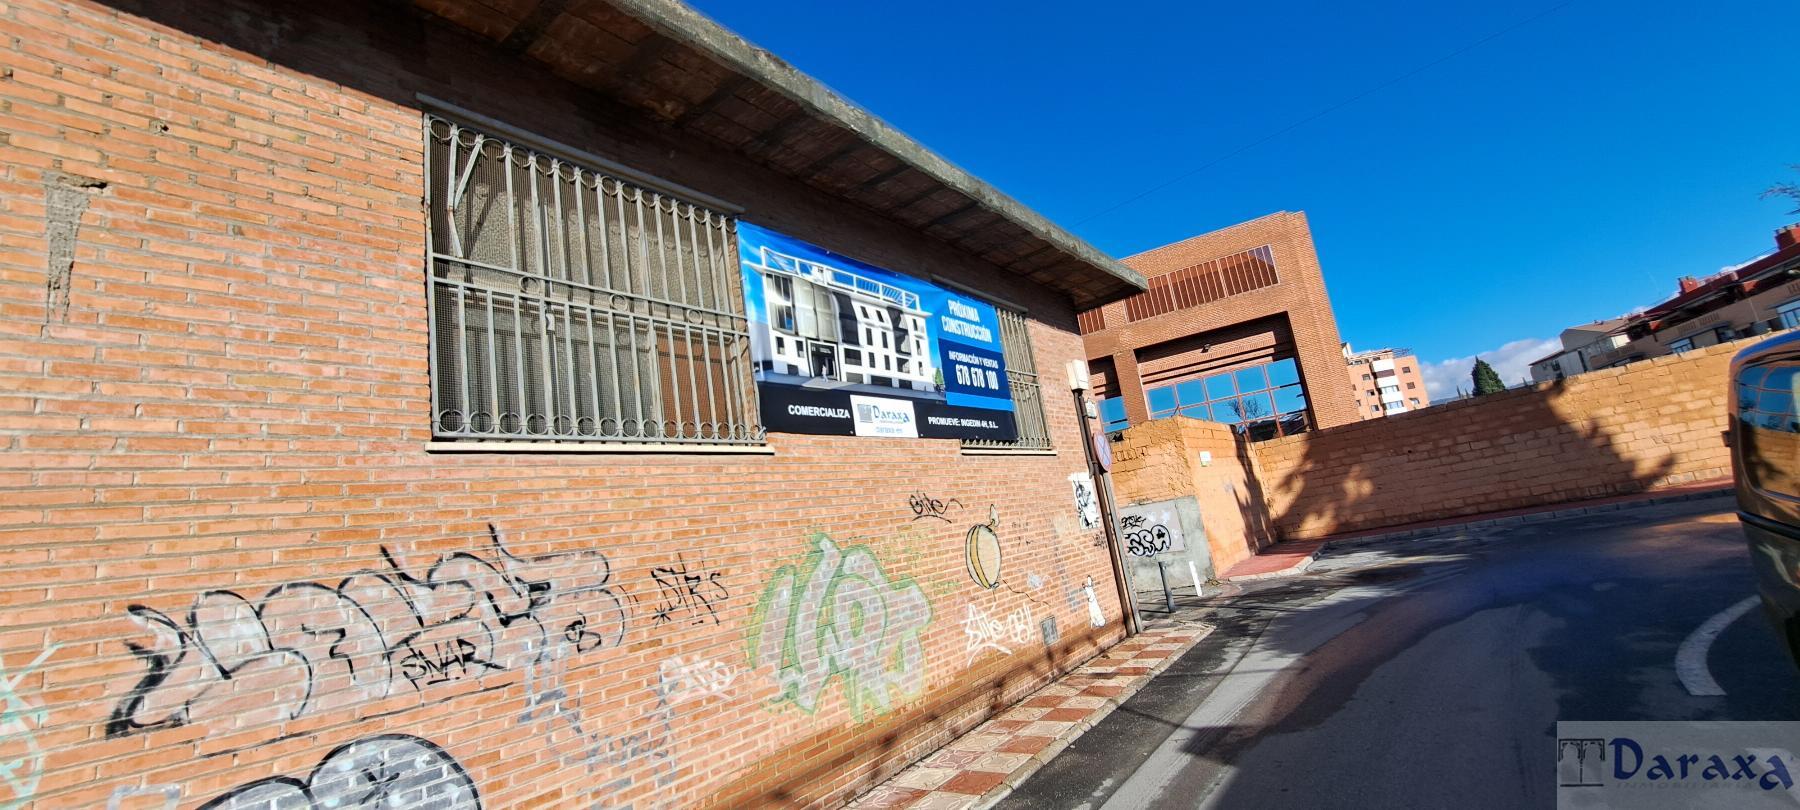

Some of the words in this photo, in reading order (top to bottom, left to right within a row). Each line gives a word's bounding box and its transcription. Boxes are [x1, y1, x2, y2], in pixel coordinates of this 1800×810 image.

[947, 299, 980, 323] PRÓXIMA
[941, 315, 993, 343] CONSTRUCCIÓN
[948, 350, 979, 365] INFORMACIÓN
[787, 404, 851, 419] COMERCIALIZA
[872, 404, 911, 423] Daraxa
